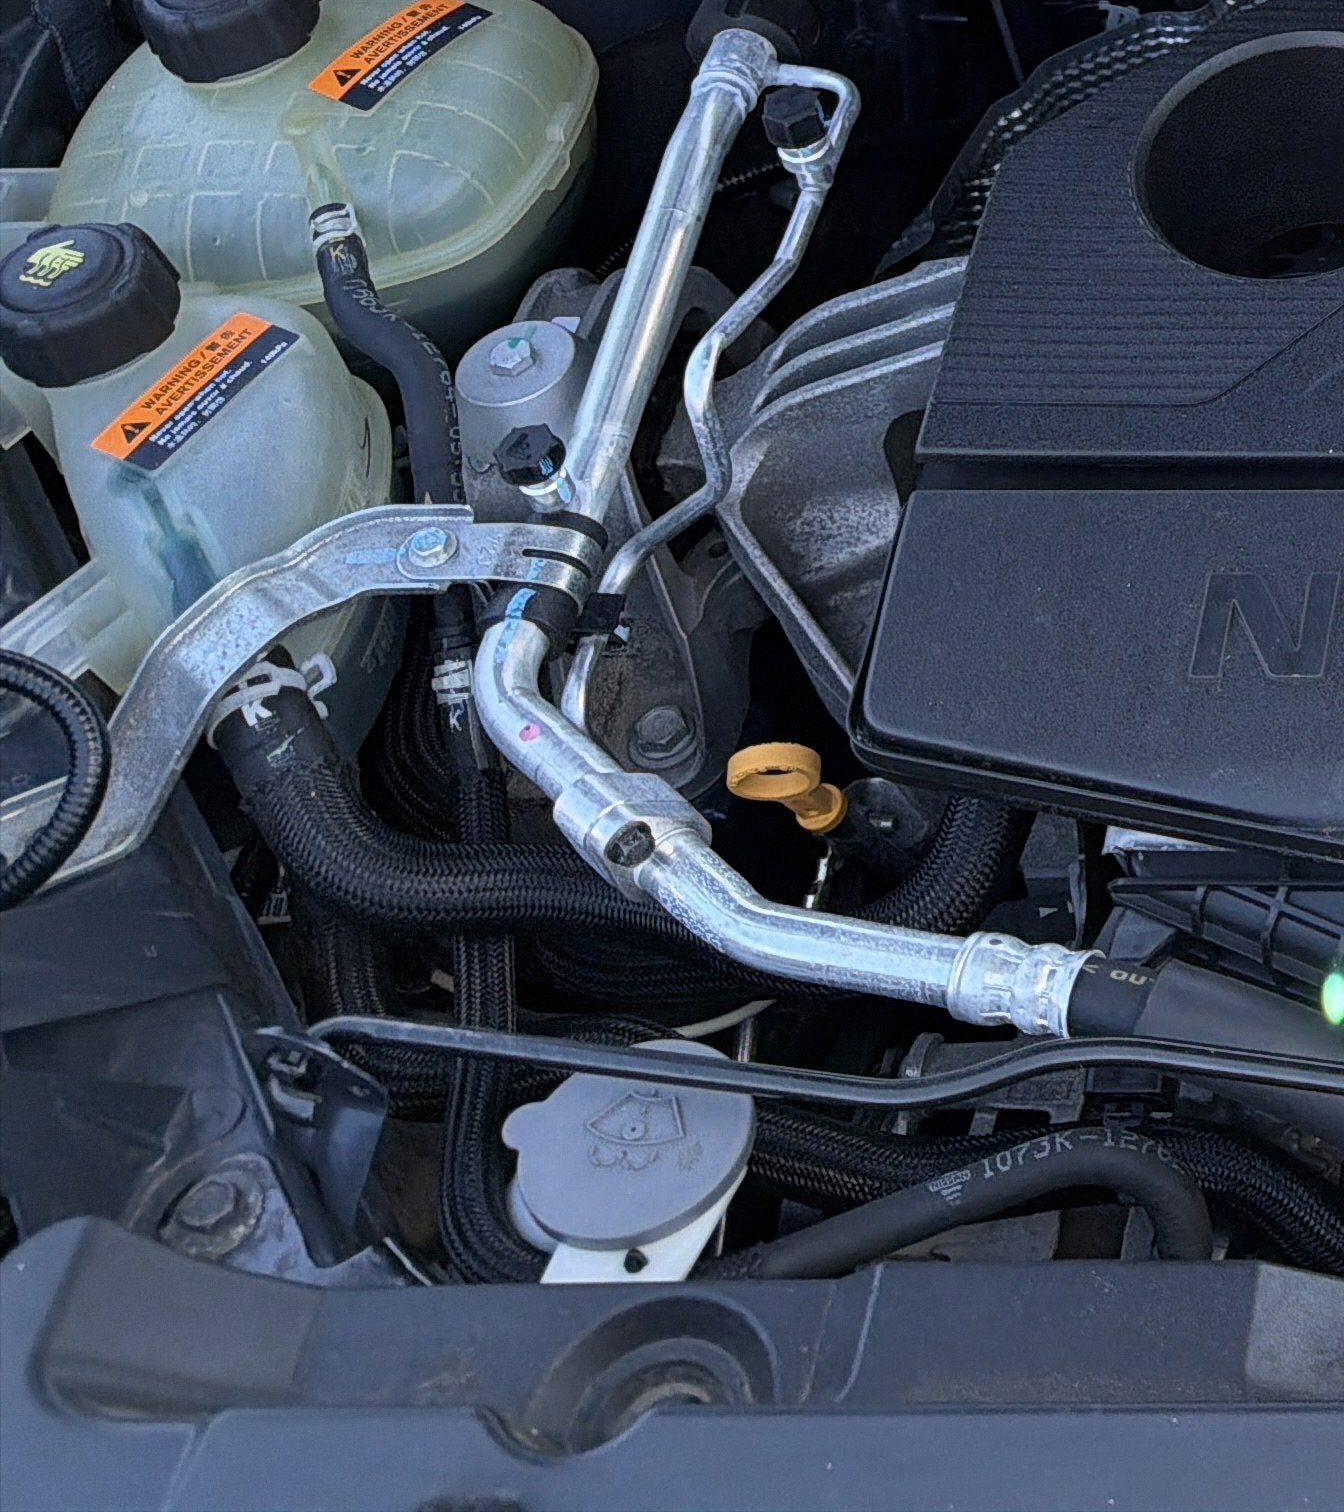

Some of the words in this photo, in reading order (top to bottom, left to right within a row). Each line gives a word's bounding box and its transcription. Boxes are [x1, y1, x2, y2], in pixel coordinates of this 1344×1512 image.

[350, 22, 402, 58] WARNING
[364, 3, 448, 63] AVERTISSEMENT
[141, 359, 200, 408] WARNING
[155, 329, 250, 414] AVERTISSEMENT
